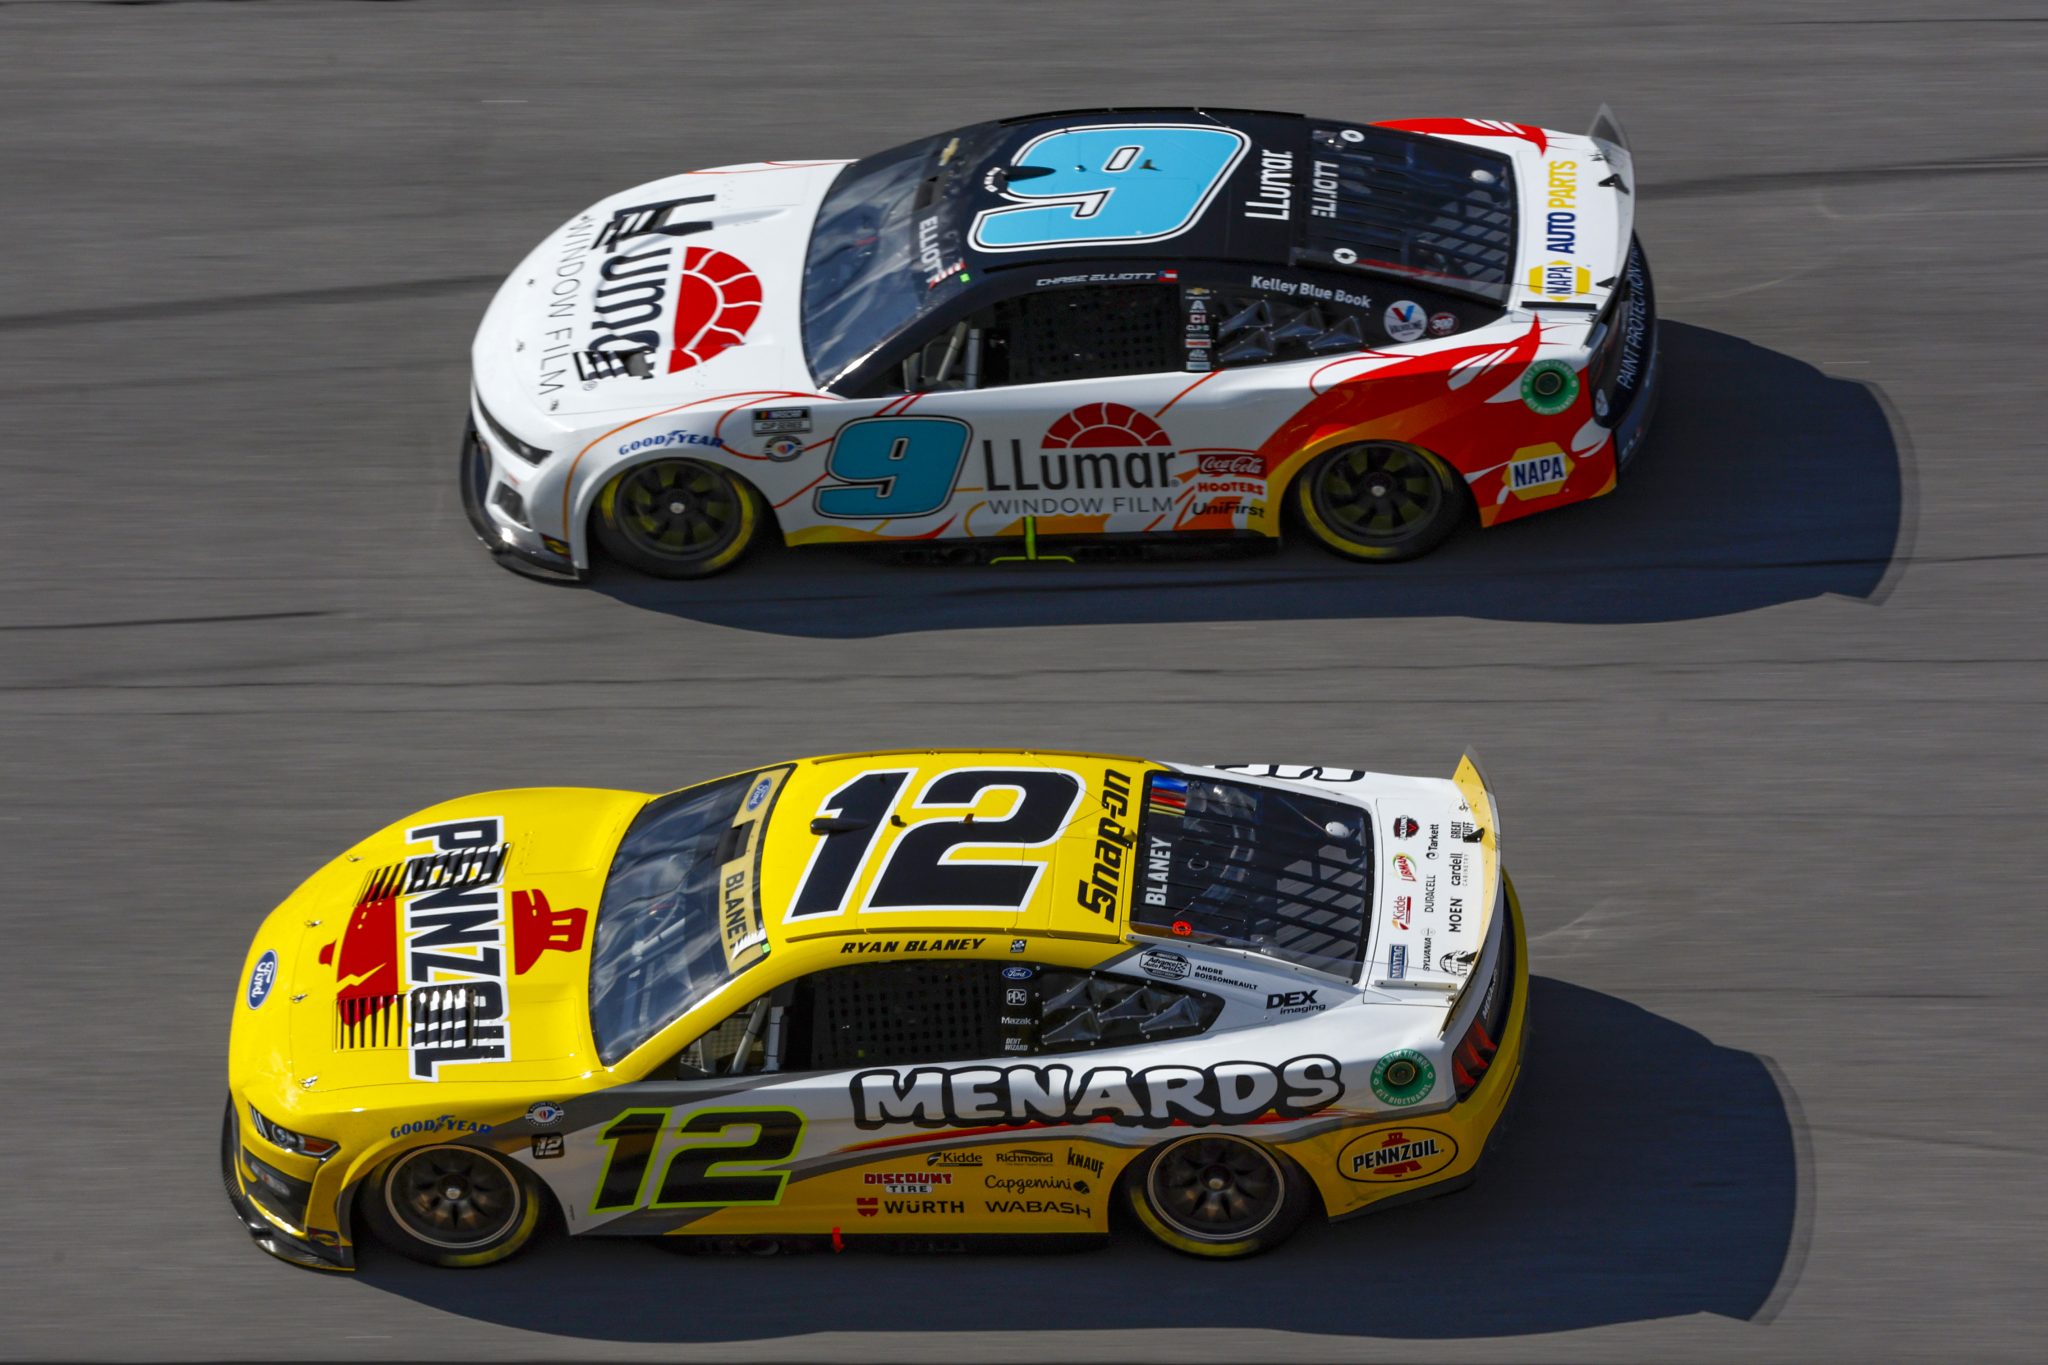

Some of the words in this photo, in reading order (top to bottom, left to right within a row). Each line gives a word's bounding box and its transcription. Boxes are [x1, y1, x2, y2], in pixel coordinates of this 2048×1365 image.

[968, 122, 1252, 253] 9
[1245, 149, 1293, 221] LLumar
[1547, 160, 1577, 209] PARTS
[1547, 211, 1576, 254] AUTO
[547, 218, 596, 318] WINDOW
[1036, 274, 1089, 287] CHASE
[1089, 272, 1157, 283] ELLIOTT
[1547, 265, 1573, 294] NAPA
[1250, 275, 1299, 296] Kelley
[1299, 282, 1333, 300] Blue
[1334, 289, 1372, 309] Book
[538, 327, 573, 395] FILM
[1616, 340, 1640, 390] PAINT
[813, 415, 973, 518] 9
[982, 439, 1176, 491] LLumar
[1512, 453, 1566, 487] NAPA
[1196, 482, 1265, 496] HOOTERS
[989, 497, 1105, 515] WINDOW
[1112, 497, 1174, 513] FILM
[1191, 502, 1266, 519] UniFirst
[750, 779, 771, 809] Ford
[782, 766, 1087, 925] 12
[1077, 768, 1132, 923] Snap-on
[1428, 823, 1440, 851] Tarkett
[1450, 820, 1462, 839] GREAT
[1145, 836, 1172, 907] BLANEY
[1396, 854, 1417, 883] LIBMAN
[1449, 853, 1462, 886] cardell
[1392, 895, 1406, 920] Kidde
[1424, 874, 1436, 913] DURACELL
[1448, 897, 1463, 933] MOEN
[405, 815, 512, 1083] PENNZOIL
[840, 940, 902, 955] RYAN
[904, 937, 987, 953] BLANEY
[1391, 945, 1405, 979] MAYTAG
[1422, 937, 1432, 972] SYLVANIA
[251, 960, 275, 997] Ford
[1007, 967, 1027, 978] Ford
[1196, 964, 1224, 976] ANDRE
[1008, 990, 1025, 1003] PPG
[1266, 989, 1320, 1010] DEX
[1279, 1003, 1327, 1016] imaging
[1001, 1016, 1032, 1025] Mazak
[849, 1054, 1346, 1130] MENARDS
[587, 1105, 809, 1216] 12
[942, 1152, 983, 1164] Kidde
[996, 1151, 1054, 1164] Richmond
[1352, 1138, 1441, 1174] PENNZOIL
[863, 1172, 952, 1185] DISCOUNT
[887, 1185, 930, 1194] TIRE
[985, 1174, 1072, 1194] Capgemini
[985, 1201, 1092, 1219] WABASH
